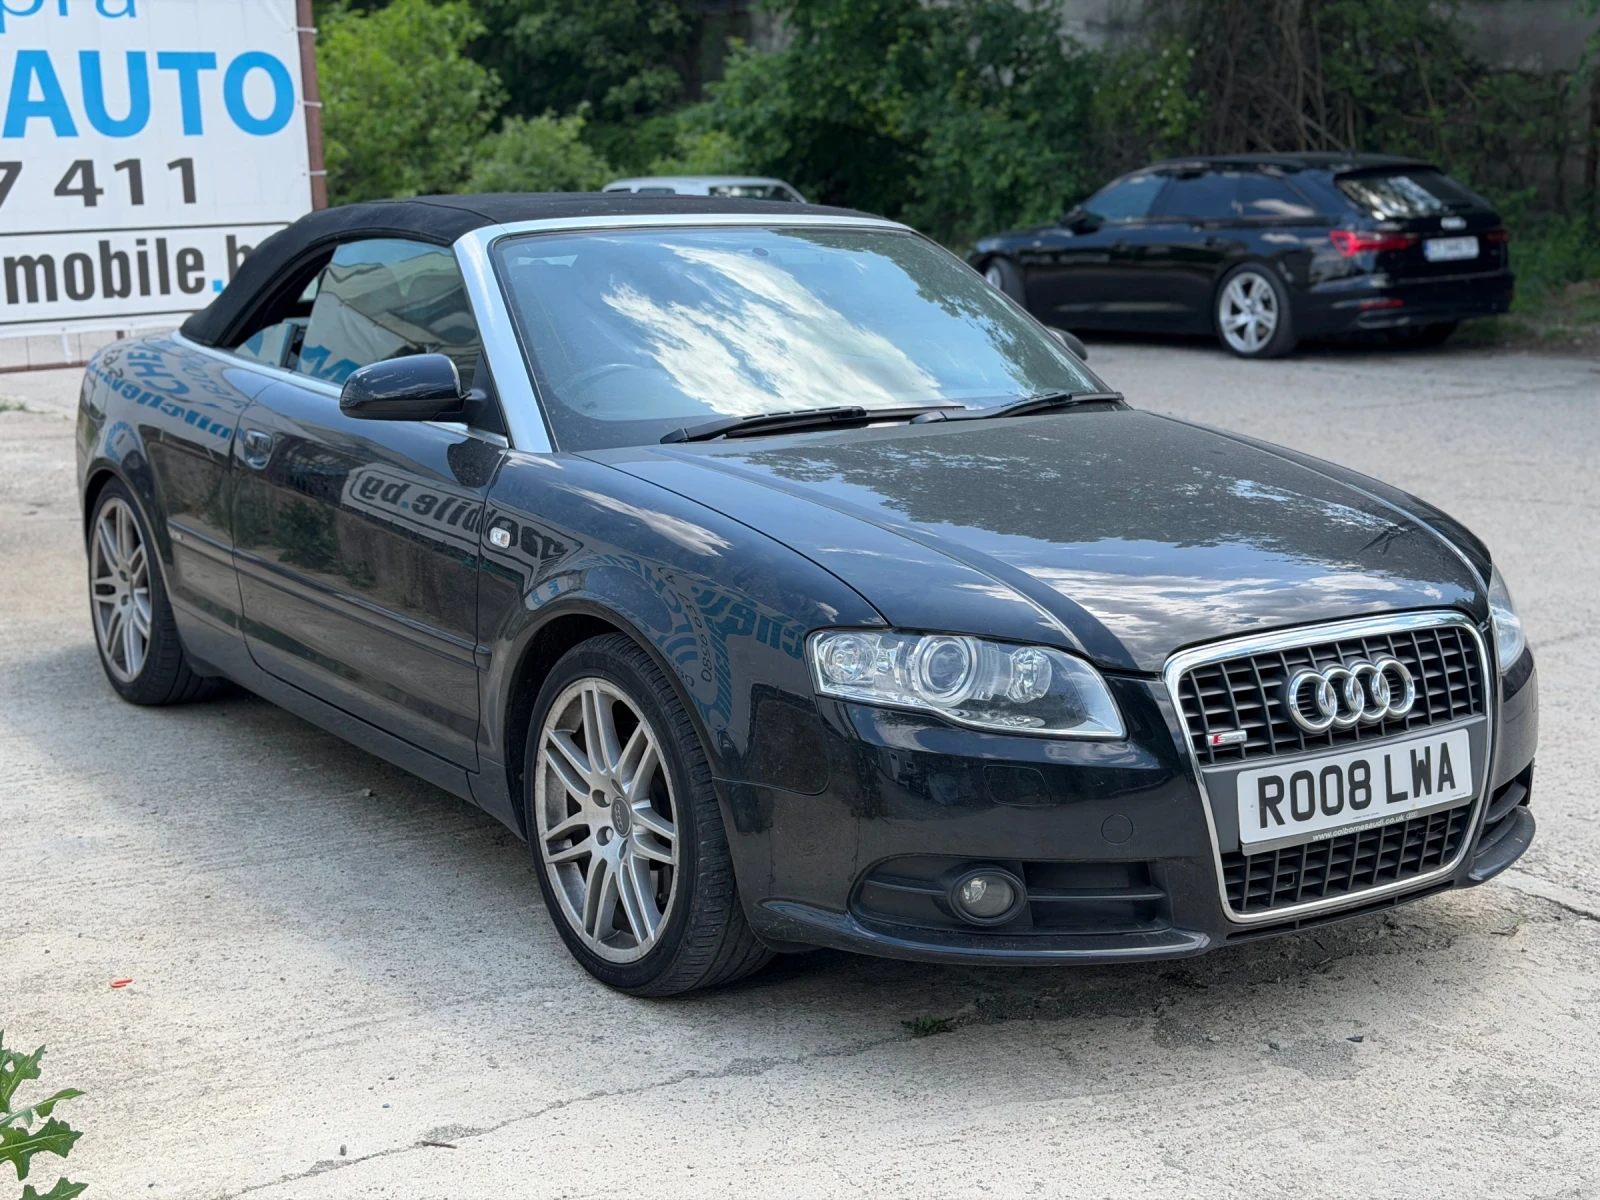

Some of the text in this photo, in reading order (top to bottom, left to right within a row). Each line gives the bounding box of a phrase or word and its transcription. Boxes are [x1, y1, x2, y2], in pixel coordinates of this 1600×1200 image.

[2, 50, 295, 138] AUTO
[54, 158, 197, 207] 411
[1257, 742, 1456, 829] RO08 LWA
